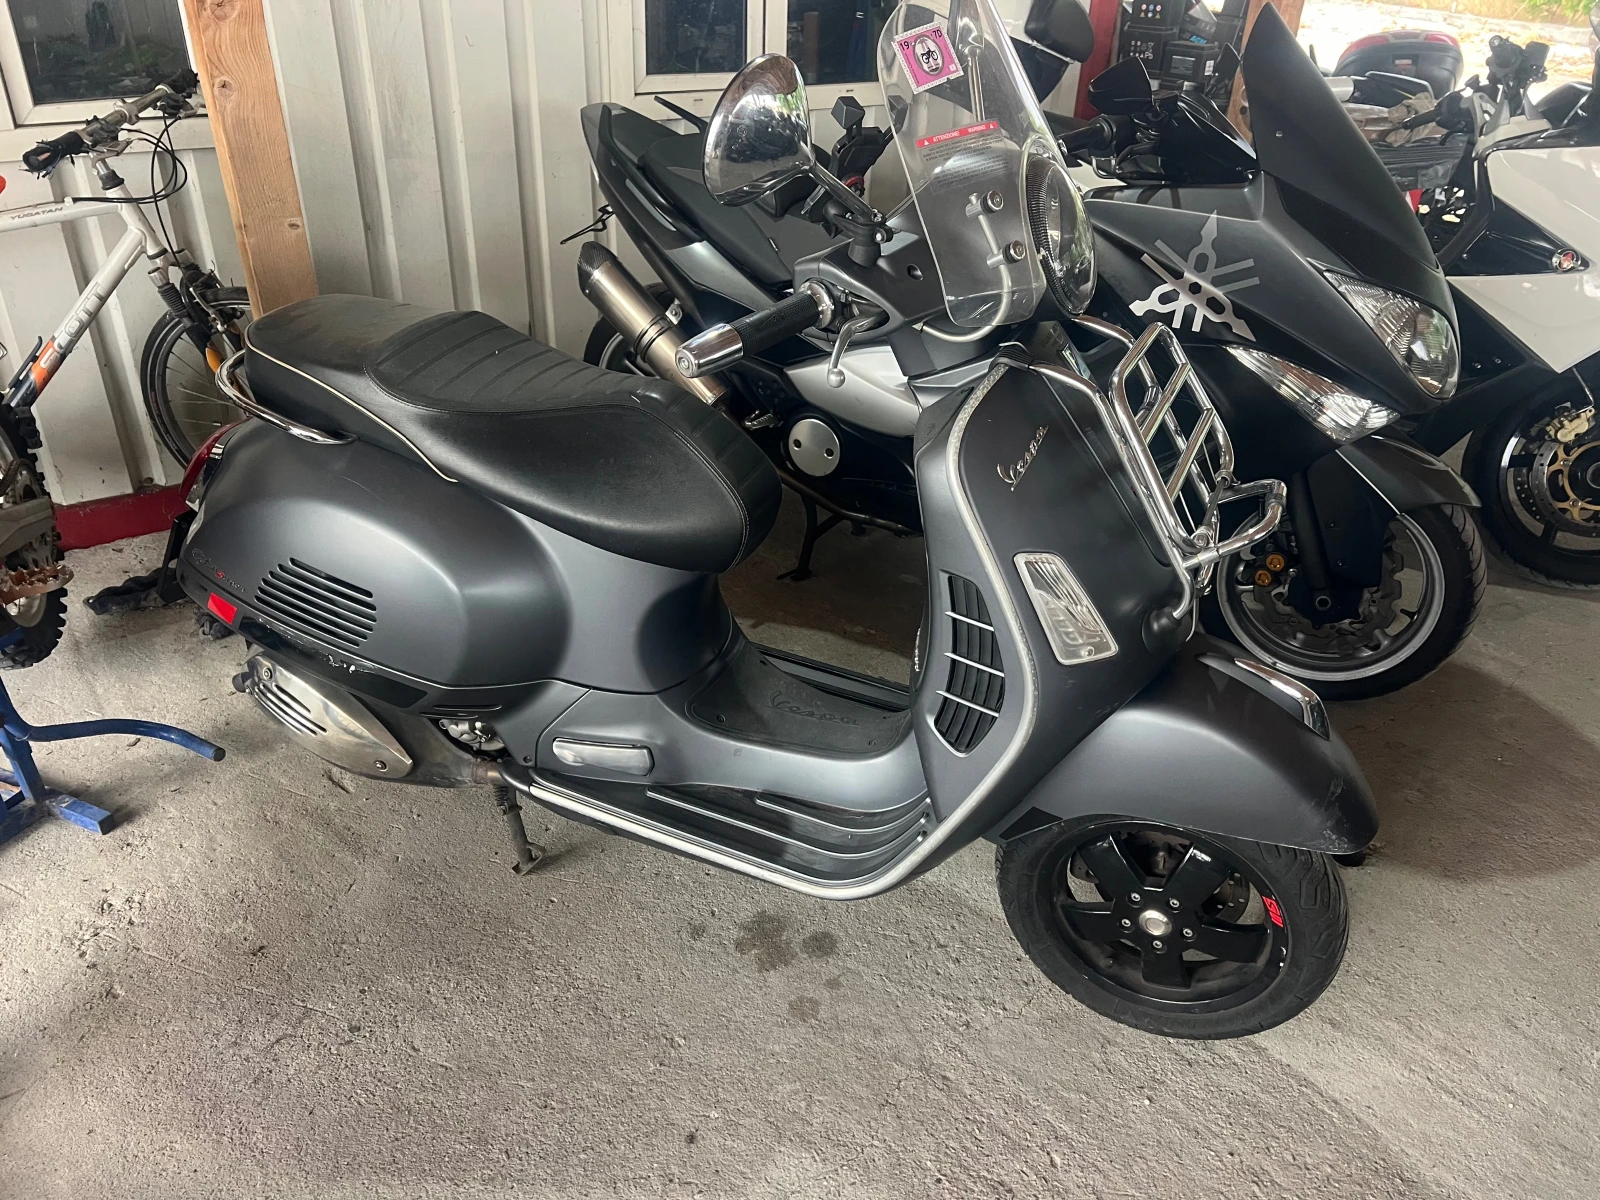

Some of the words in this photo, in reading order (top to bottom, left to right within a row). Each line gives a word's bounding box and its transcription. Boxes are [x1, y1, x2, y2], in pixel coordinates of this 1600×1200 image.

[900, 41, 910, 51] 19
[40, 282, 105, 373] SCOTT
[997, 424, 1049, 492] Vespa
[767, 690, 861, 728] Vespa
